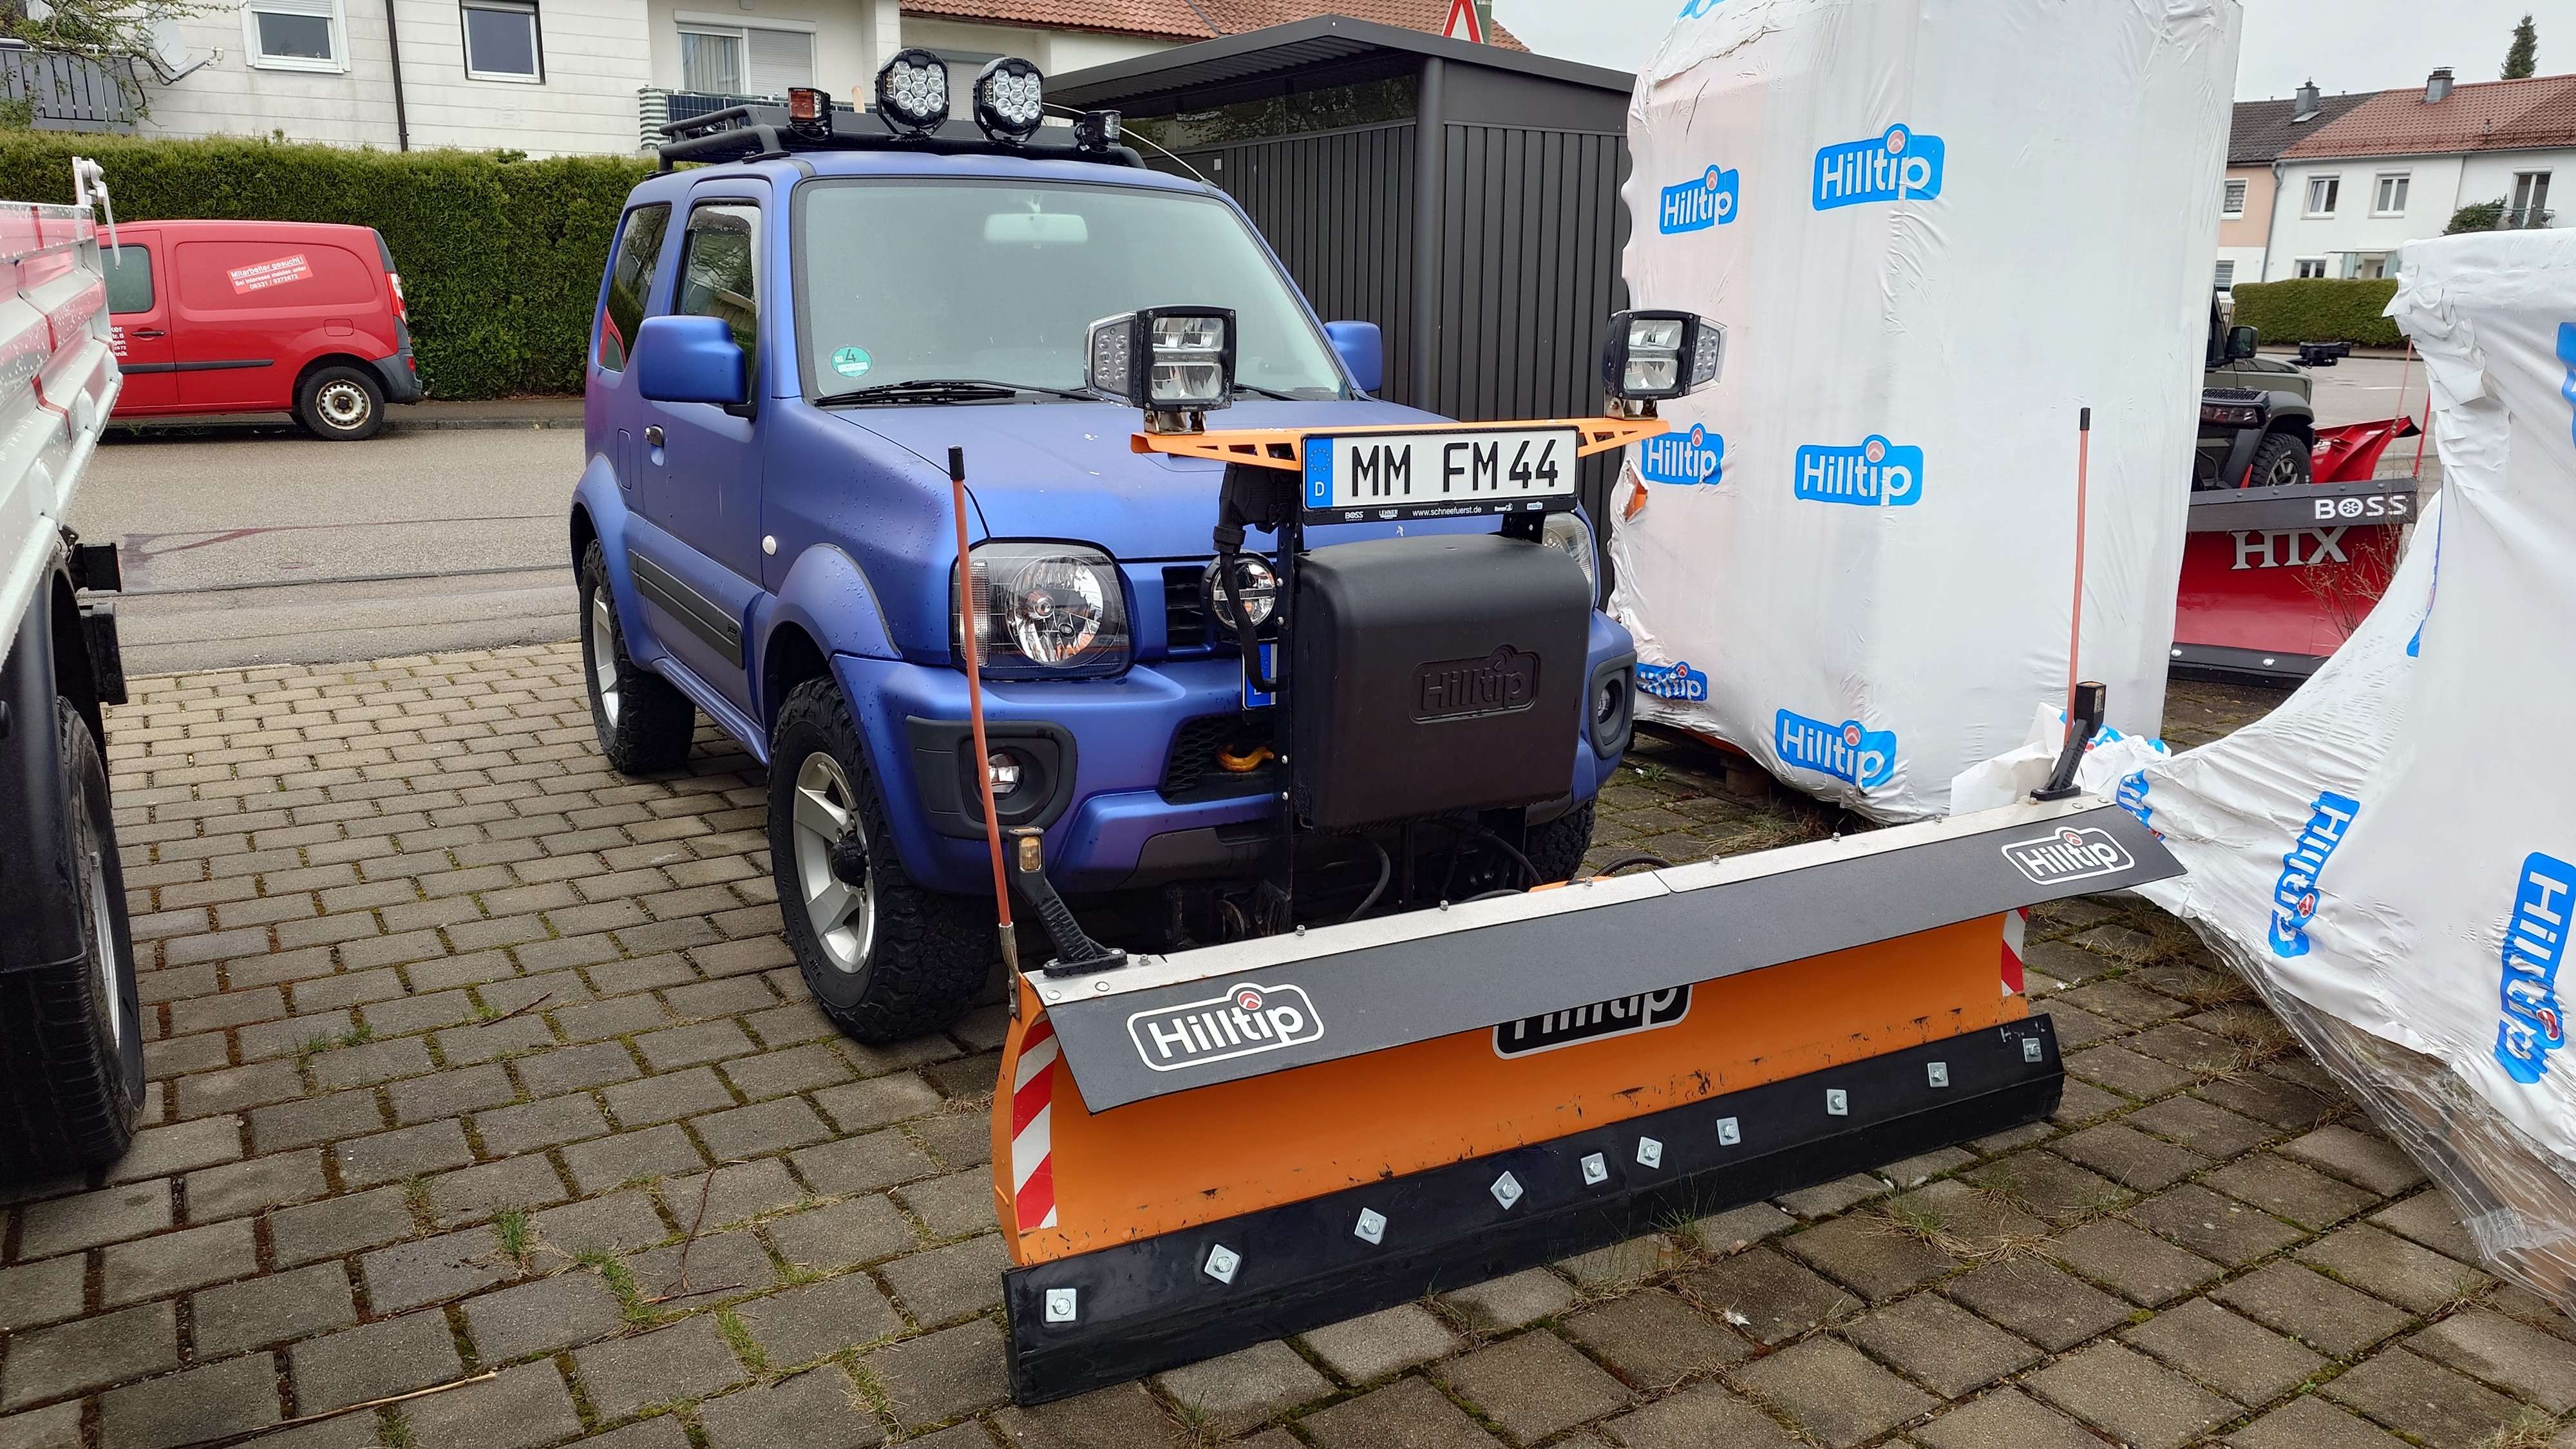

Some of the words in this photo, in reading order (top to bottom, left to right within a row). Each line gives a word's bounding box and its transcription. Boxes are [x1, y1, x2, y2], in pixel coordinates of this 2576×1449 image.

[1821, 129, 1931, 201] Hilltip
[1663, 169, 1732, 227] Hilltip
[231, 264, 270, 278] Mitarbeiter
[845, 348, 857, 361] 4
[1314, 481, 1325, 497] D
[1352, 444, 1410, 497] MM
[1443, 440, 1498, 492] FM
[1508, 439, 1558, 489] 44
[1647, 428, 1716, 482] Hilltip
[1803, 440, 1912, 507] Hilltip
[1345, 511, 1364, 519] BOSS
[1412, 506, 1482, 516] www.schneefuerst.de
[2315, 495, 2407, 520] BOSS
[1421, 654, 1525, 710] Hilltip
[1783, 719, 1885, 787] Hilltip
[2016, 831, 2119, 876] Hilltip
[2272, 804, 2351, 942] Hilltip
[1146, 990, 1304, 1059] Hilltip
